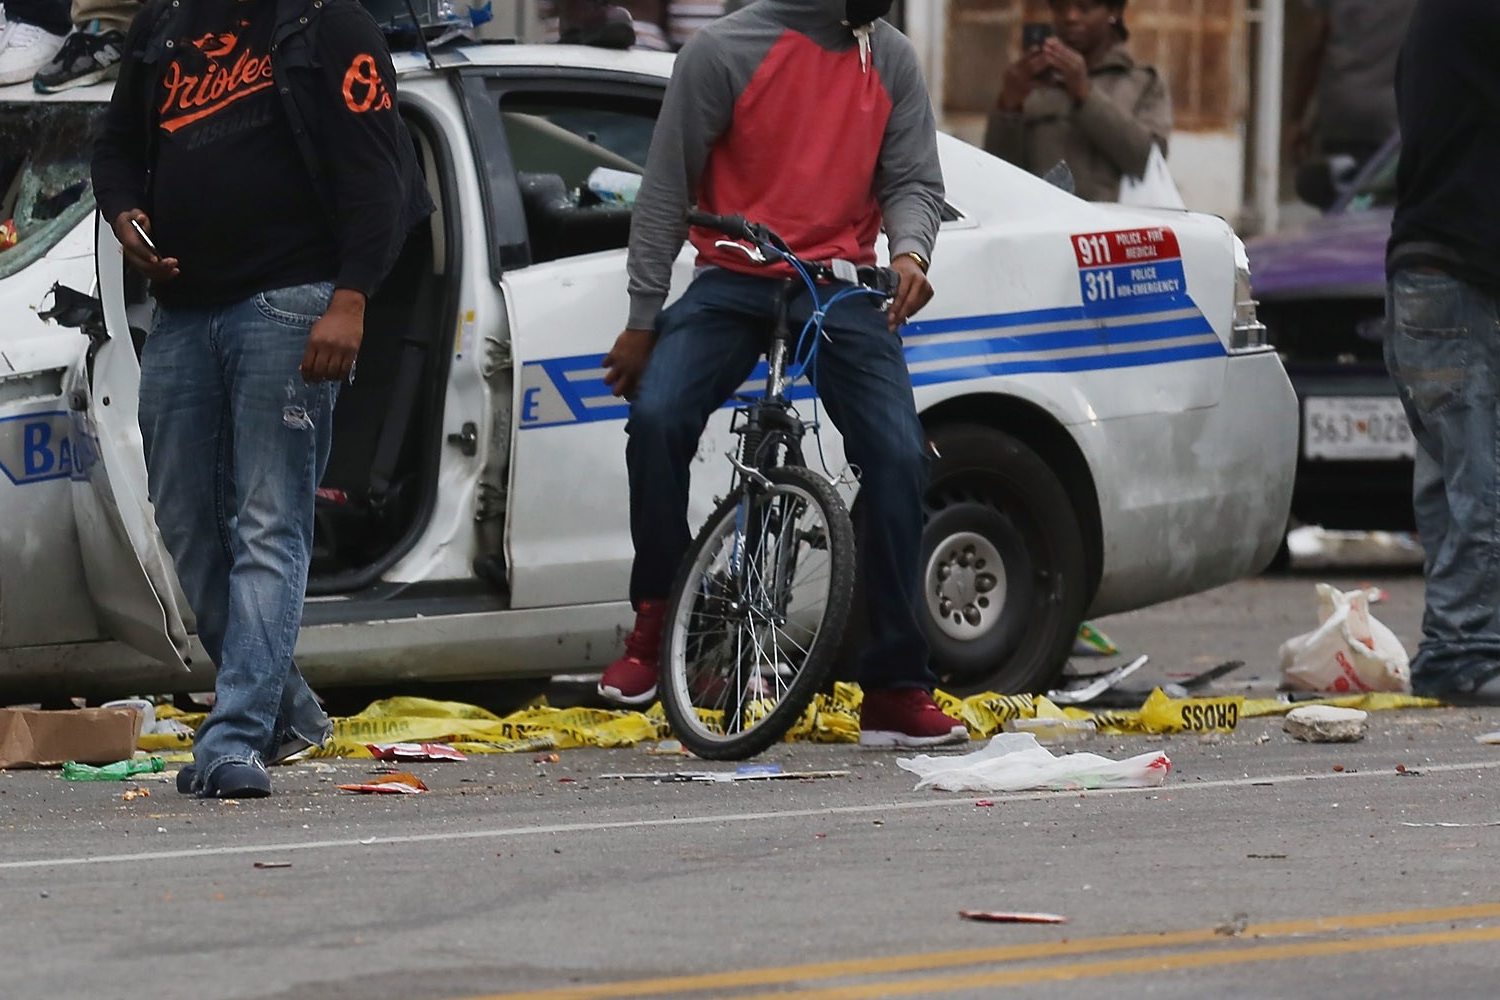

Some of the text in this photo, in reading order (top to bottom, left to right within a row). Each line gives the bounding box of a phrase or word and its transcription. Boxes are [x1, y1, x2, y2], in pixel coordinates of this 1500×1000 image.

[160, 48, 274, 115] Orioles
[341, 53, 393, 114] O's
[1077, 234, 1112, 265] 911
[1115, 231, 1142, 246] POLICE
[1146, 229, 1164, 243] FIRE
[1125, 245, 1158, 260] MEDICAL
[1084, 270, 1116, 302] 311
[1116, 278, 1180, 298] NON-EMERGENCY
[1130, 267, 1157, 281] POLICE
[1180, 701, 1238, 731] CROSS
